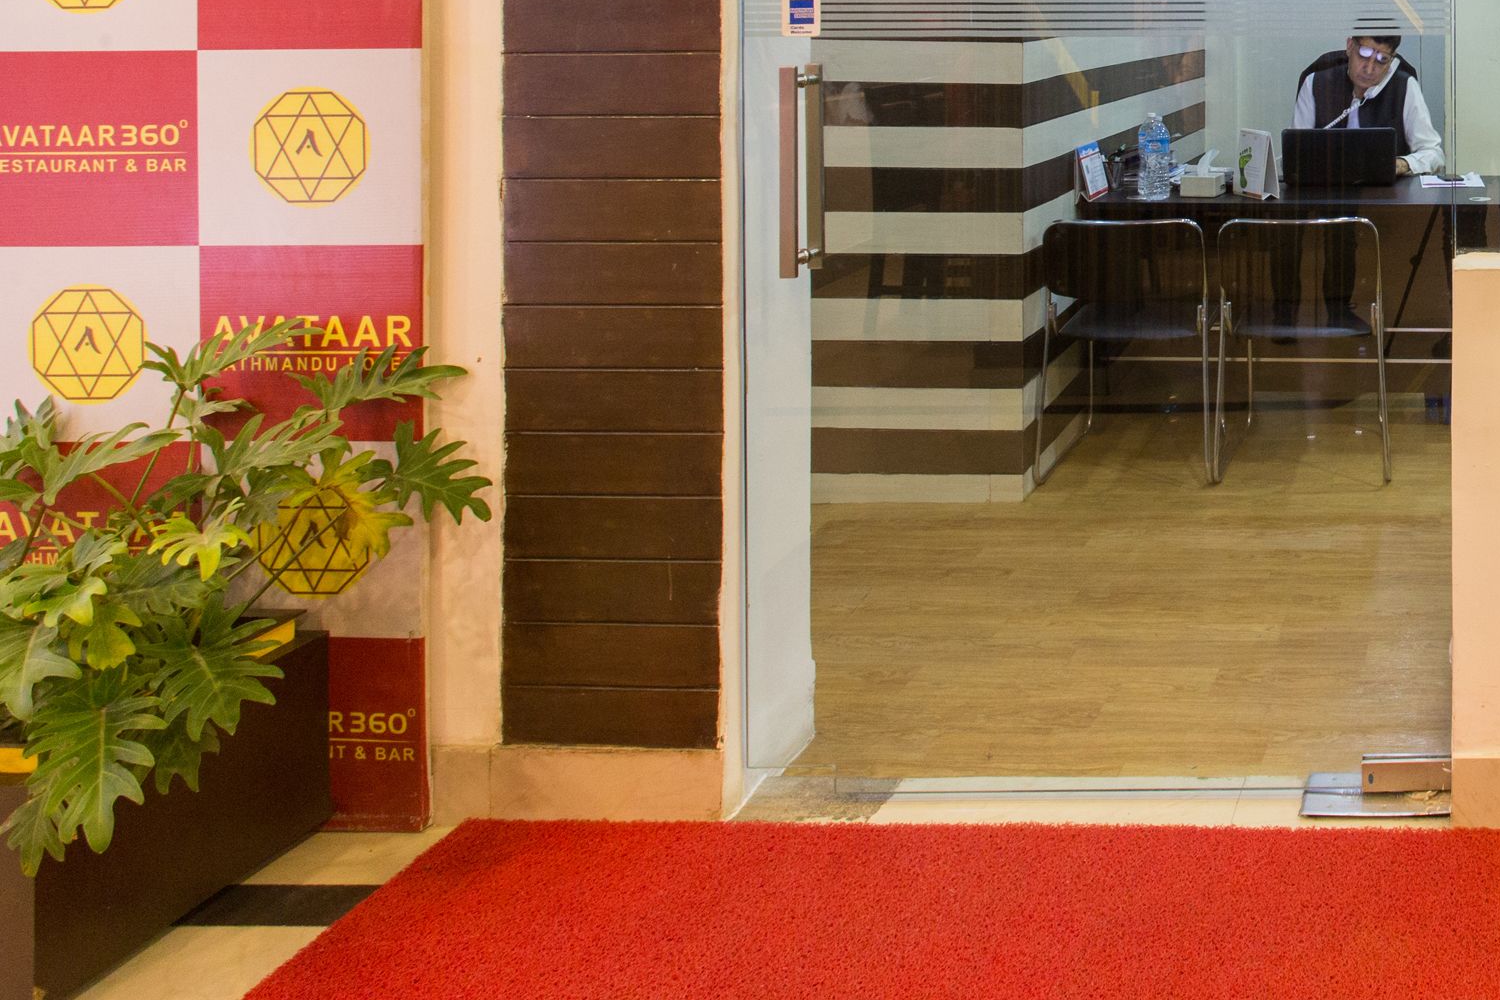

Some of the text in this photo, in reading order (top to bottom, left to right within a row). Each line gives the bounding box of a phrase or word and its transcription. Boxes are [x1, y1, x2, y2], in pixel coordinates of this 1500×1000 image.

[126, 158, 138, 173] &
[147, 158, 187, 172] BAR
[355, 746, 366, 759] &
[375, 747, 414, 761] BAR
